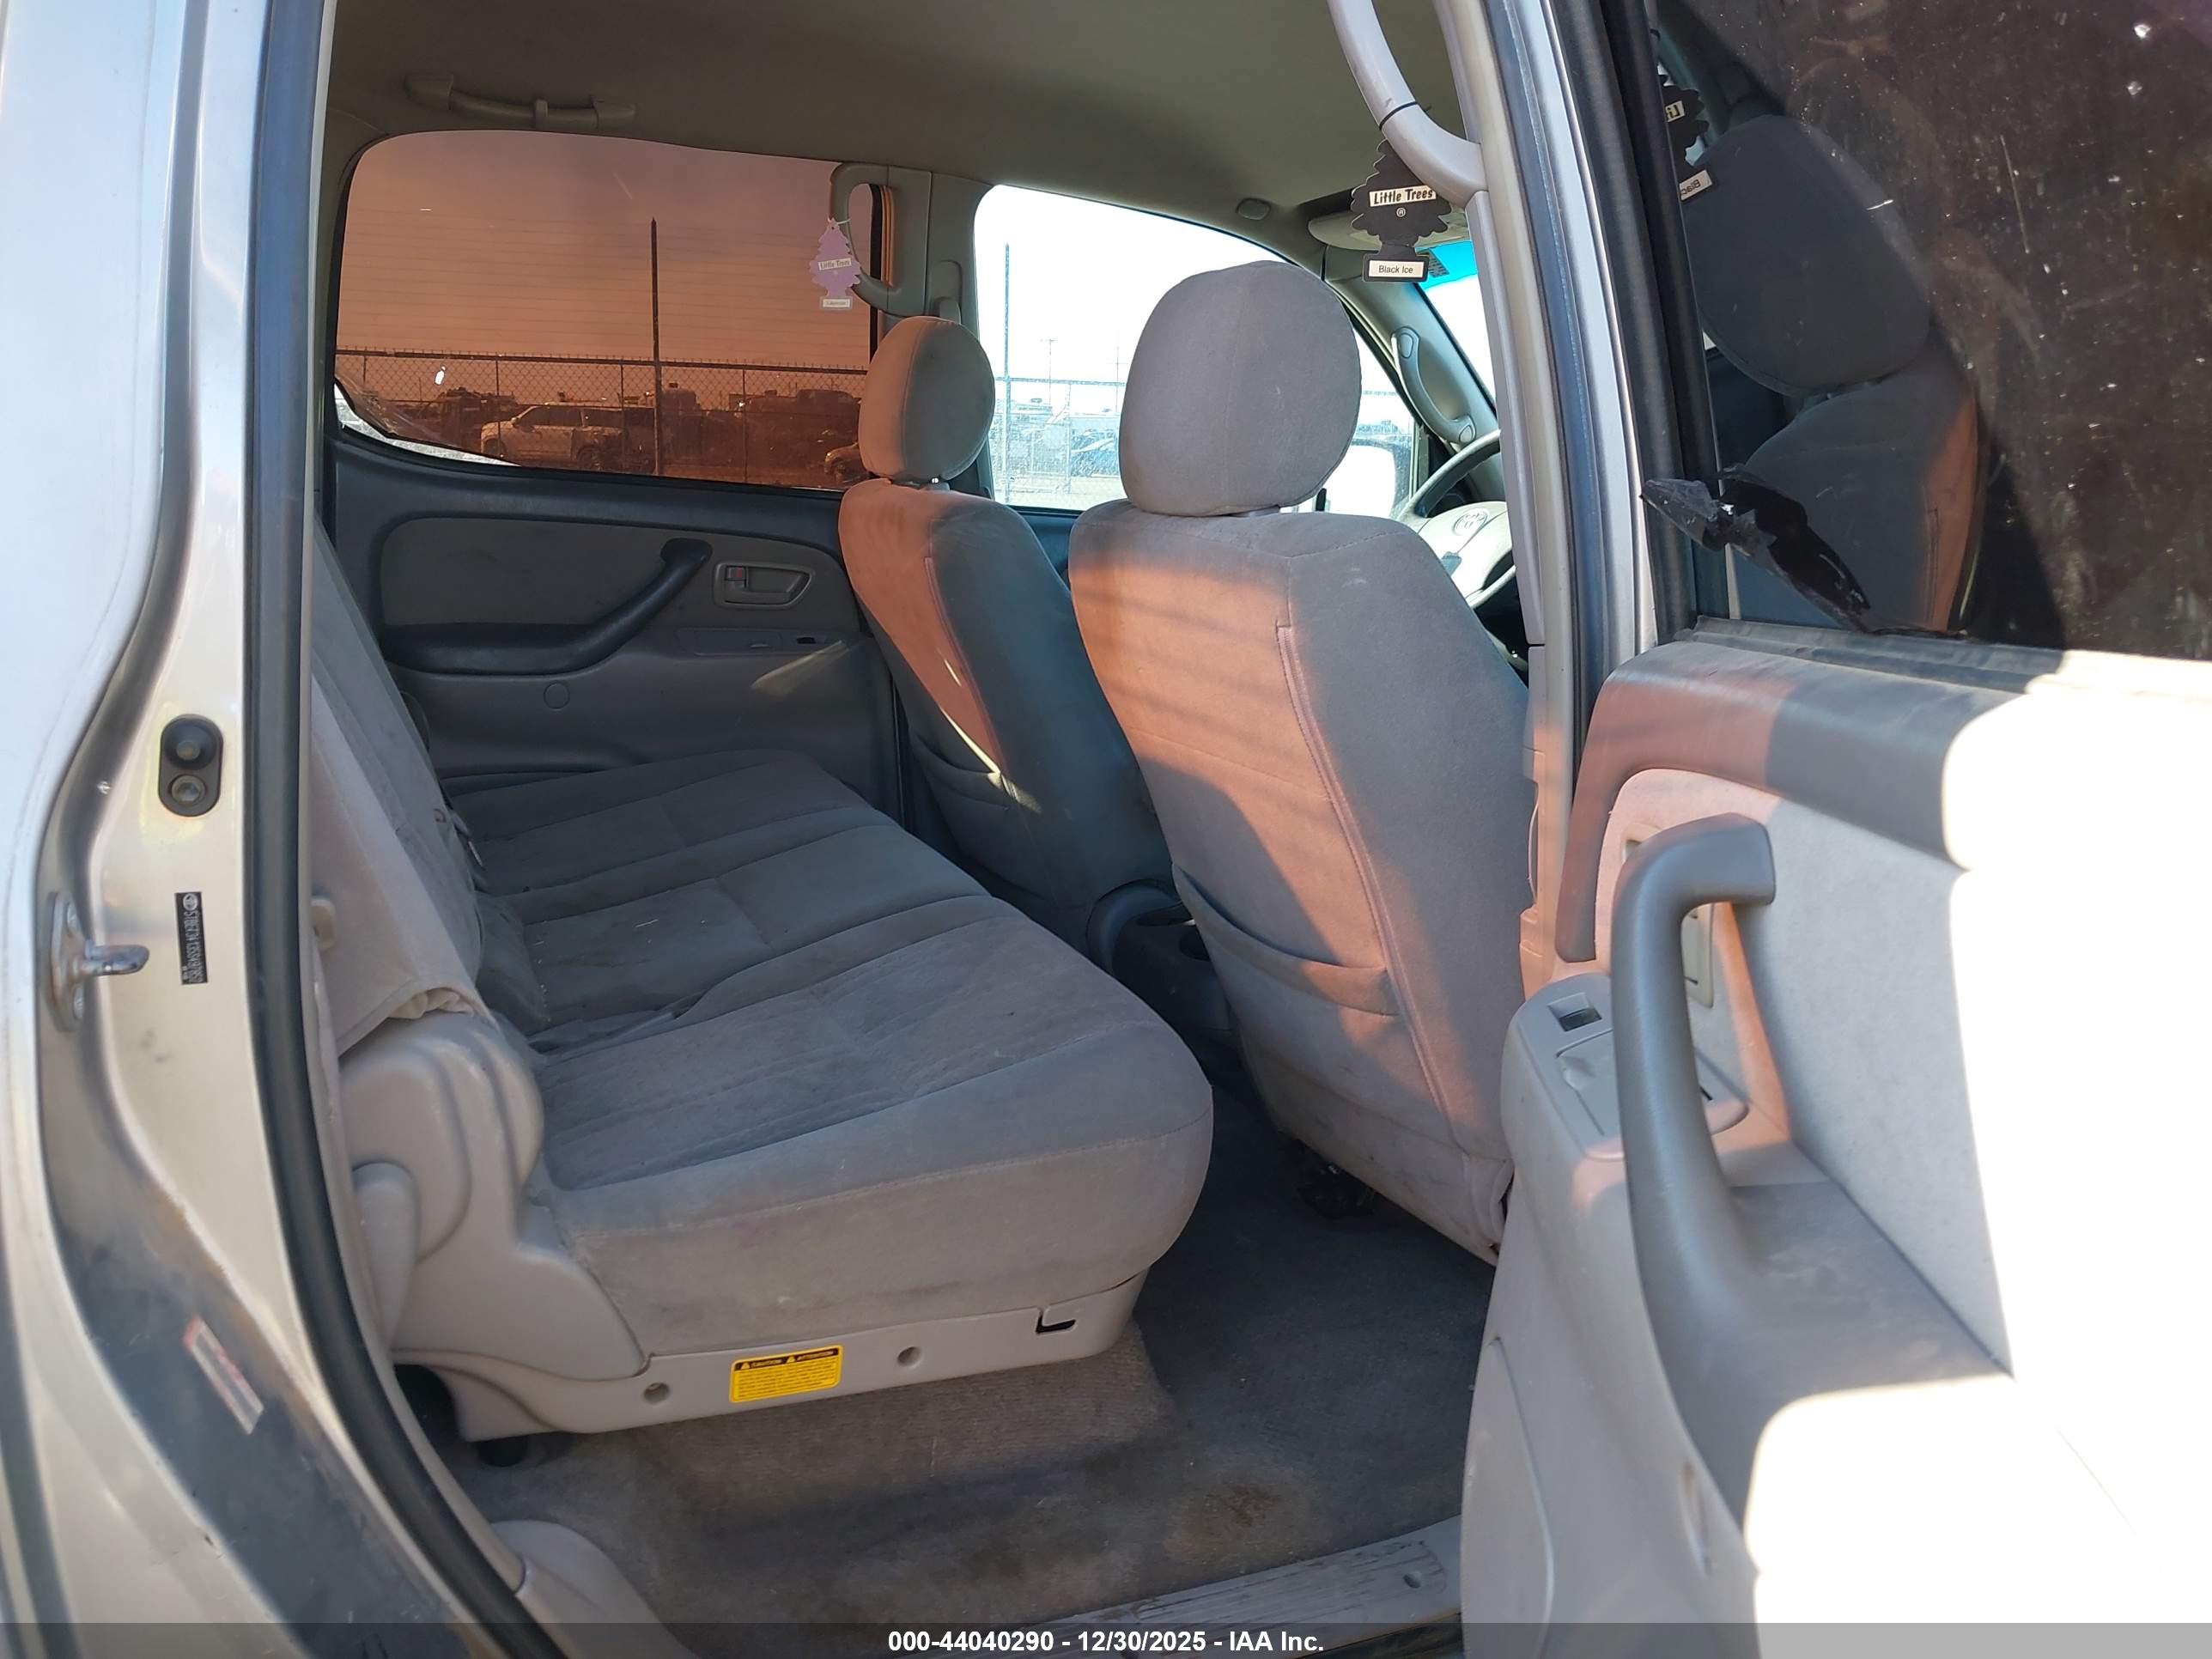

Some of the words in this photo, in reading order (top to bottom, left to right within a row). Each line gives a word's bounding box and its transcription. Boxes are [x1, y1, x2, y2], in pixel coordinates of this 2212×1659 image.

[1374, 191, 1401, 204] Little
[1405, 188, 1433, 201] Trees
[1378, 264, 1400, 274] Black
[1402, 264, 1413, 274] Ice
